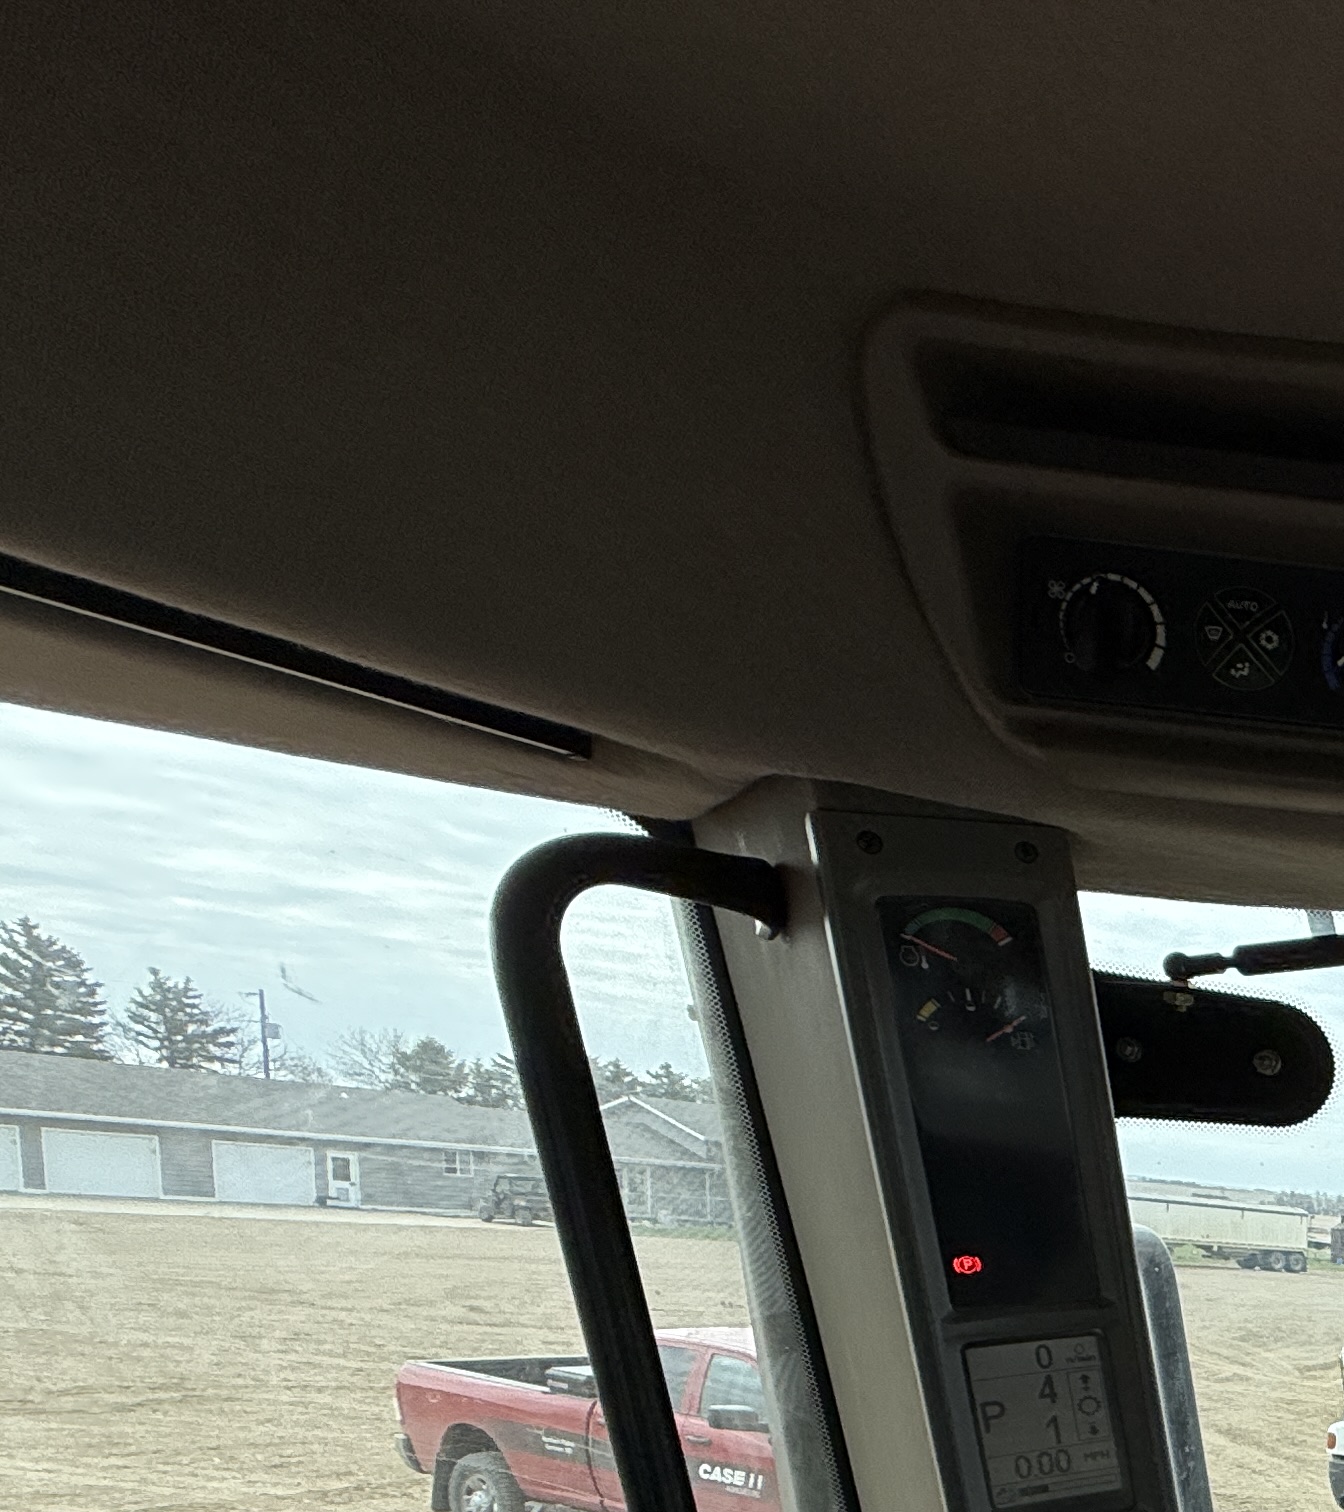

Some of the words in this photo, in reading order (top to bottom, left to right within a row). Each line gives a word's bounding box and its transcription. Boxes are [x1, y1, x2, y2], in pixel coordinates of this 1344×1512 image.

[1227, 600, 1258, 612] AUTO
[1035, 1344, 1053, 1369] 0
[1038, 1374, 1058, 1403] 4
[980, 1401, 1006, 1434] P
[1046, 1415, 1061, 1444] 1
[699, 1463, 746, 1486] CASE
[1015, 1449, 1071, 1479] 0.00
[1084, 1450, 1110, 1461] MPH
